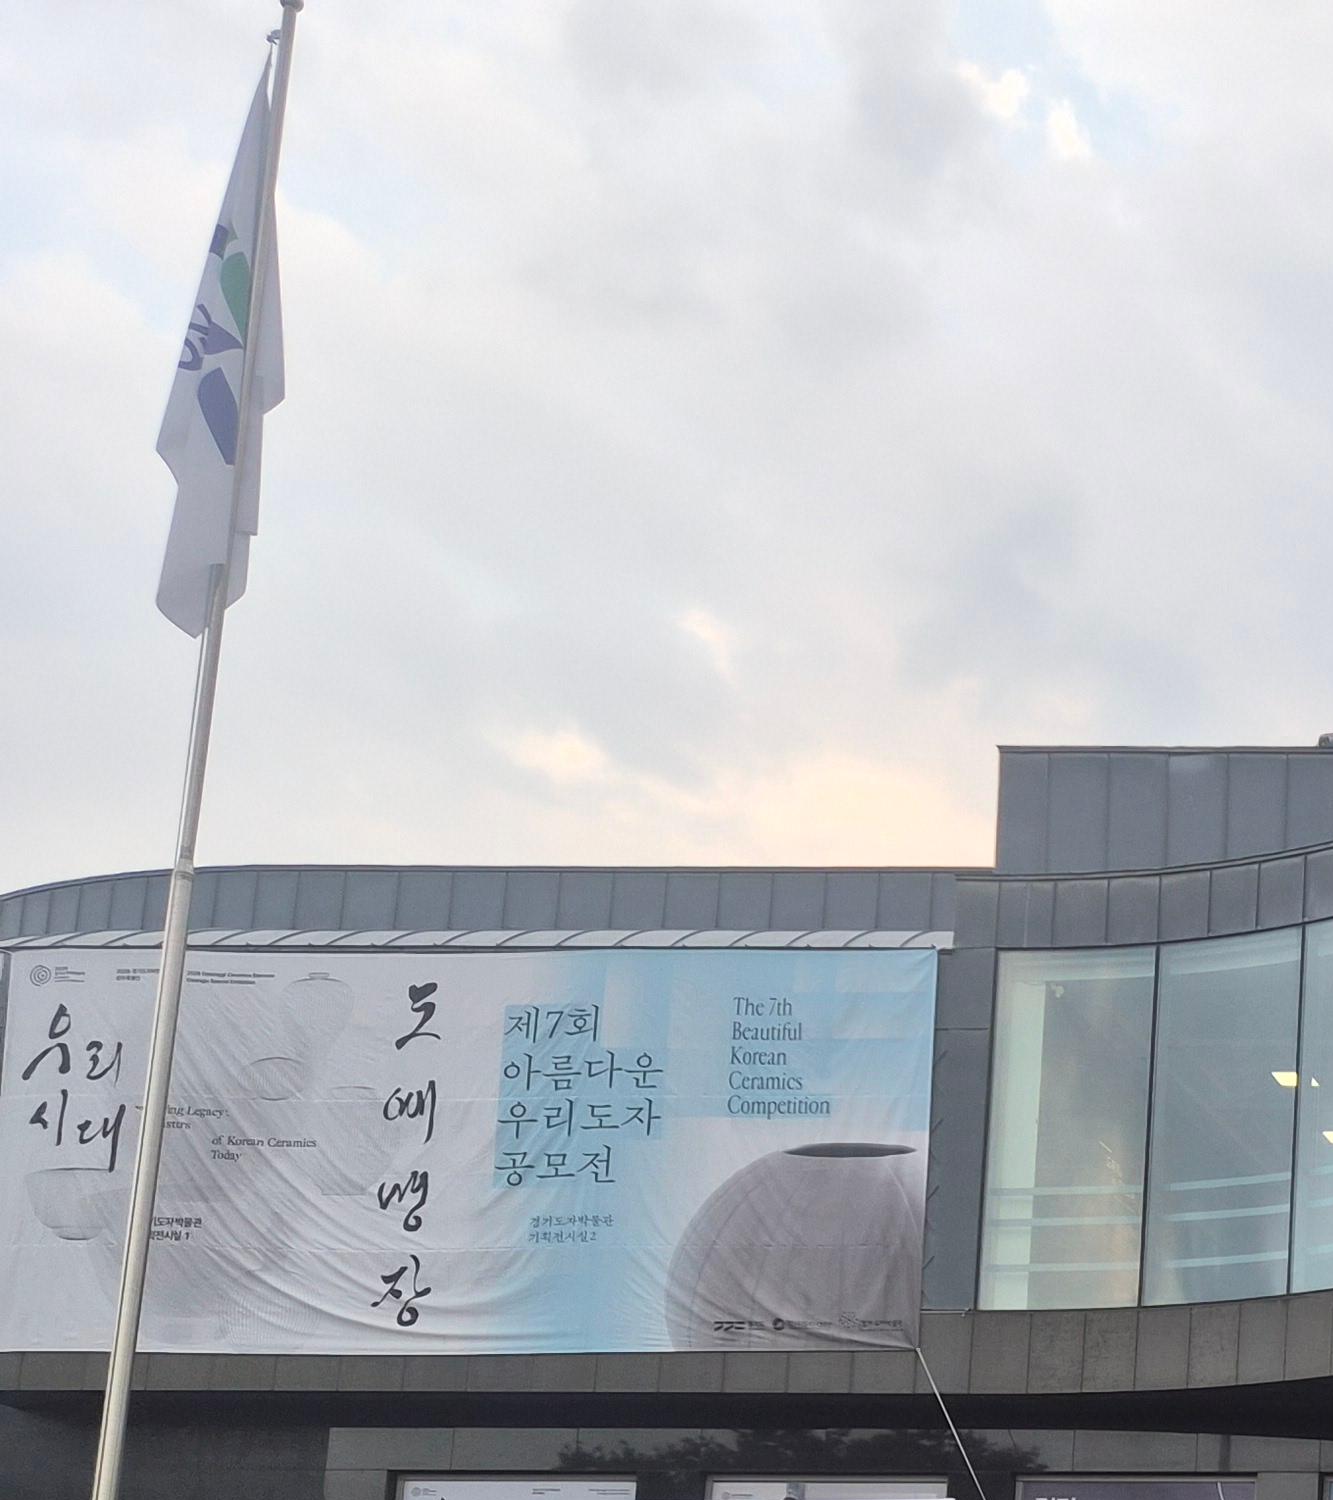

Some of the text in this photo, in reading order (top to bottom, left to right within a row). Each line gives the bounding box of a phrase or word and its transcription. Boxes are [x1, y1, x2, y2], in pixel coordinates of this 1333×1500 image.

[733, 997, 793, 1017] The 7th
[504, 1004, 601, 1044] 제7회
[731, 1021, 802, 1042] Beautiful
[22, 1003, 123, 1089] 우리
[730, 1045, 787, 1067] Korean
[503, 1051, 665, 1091] 아름다운
[728, 1071, 803, 1091] Ceramics
[497, 1097, 662, 1139] 우리도자
[726, 1095, 831, 1120] Competition
[29, 1089, 127, 1172] 시대
[211, 1135, 317, 1148] of Korean Ceramics
[211, 1150, 242, 1161] Today
[494, 1144, 617, 1187] 공모전
